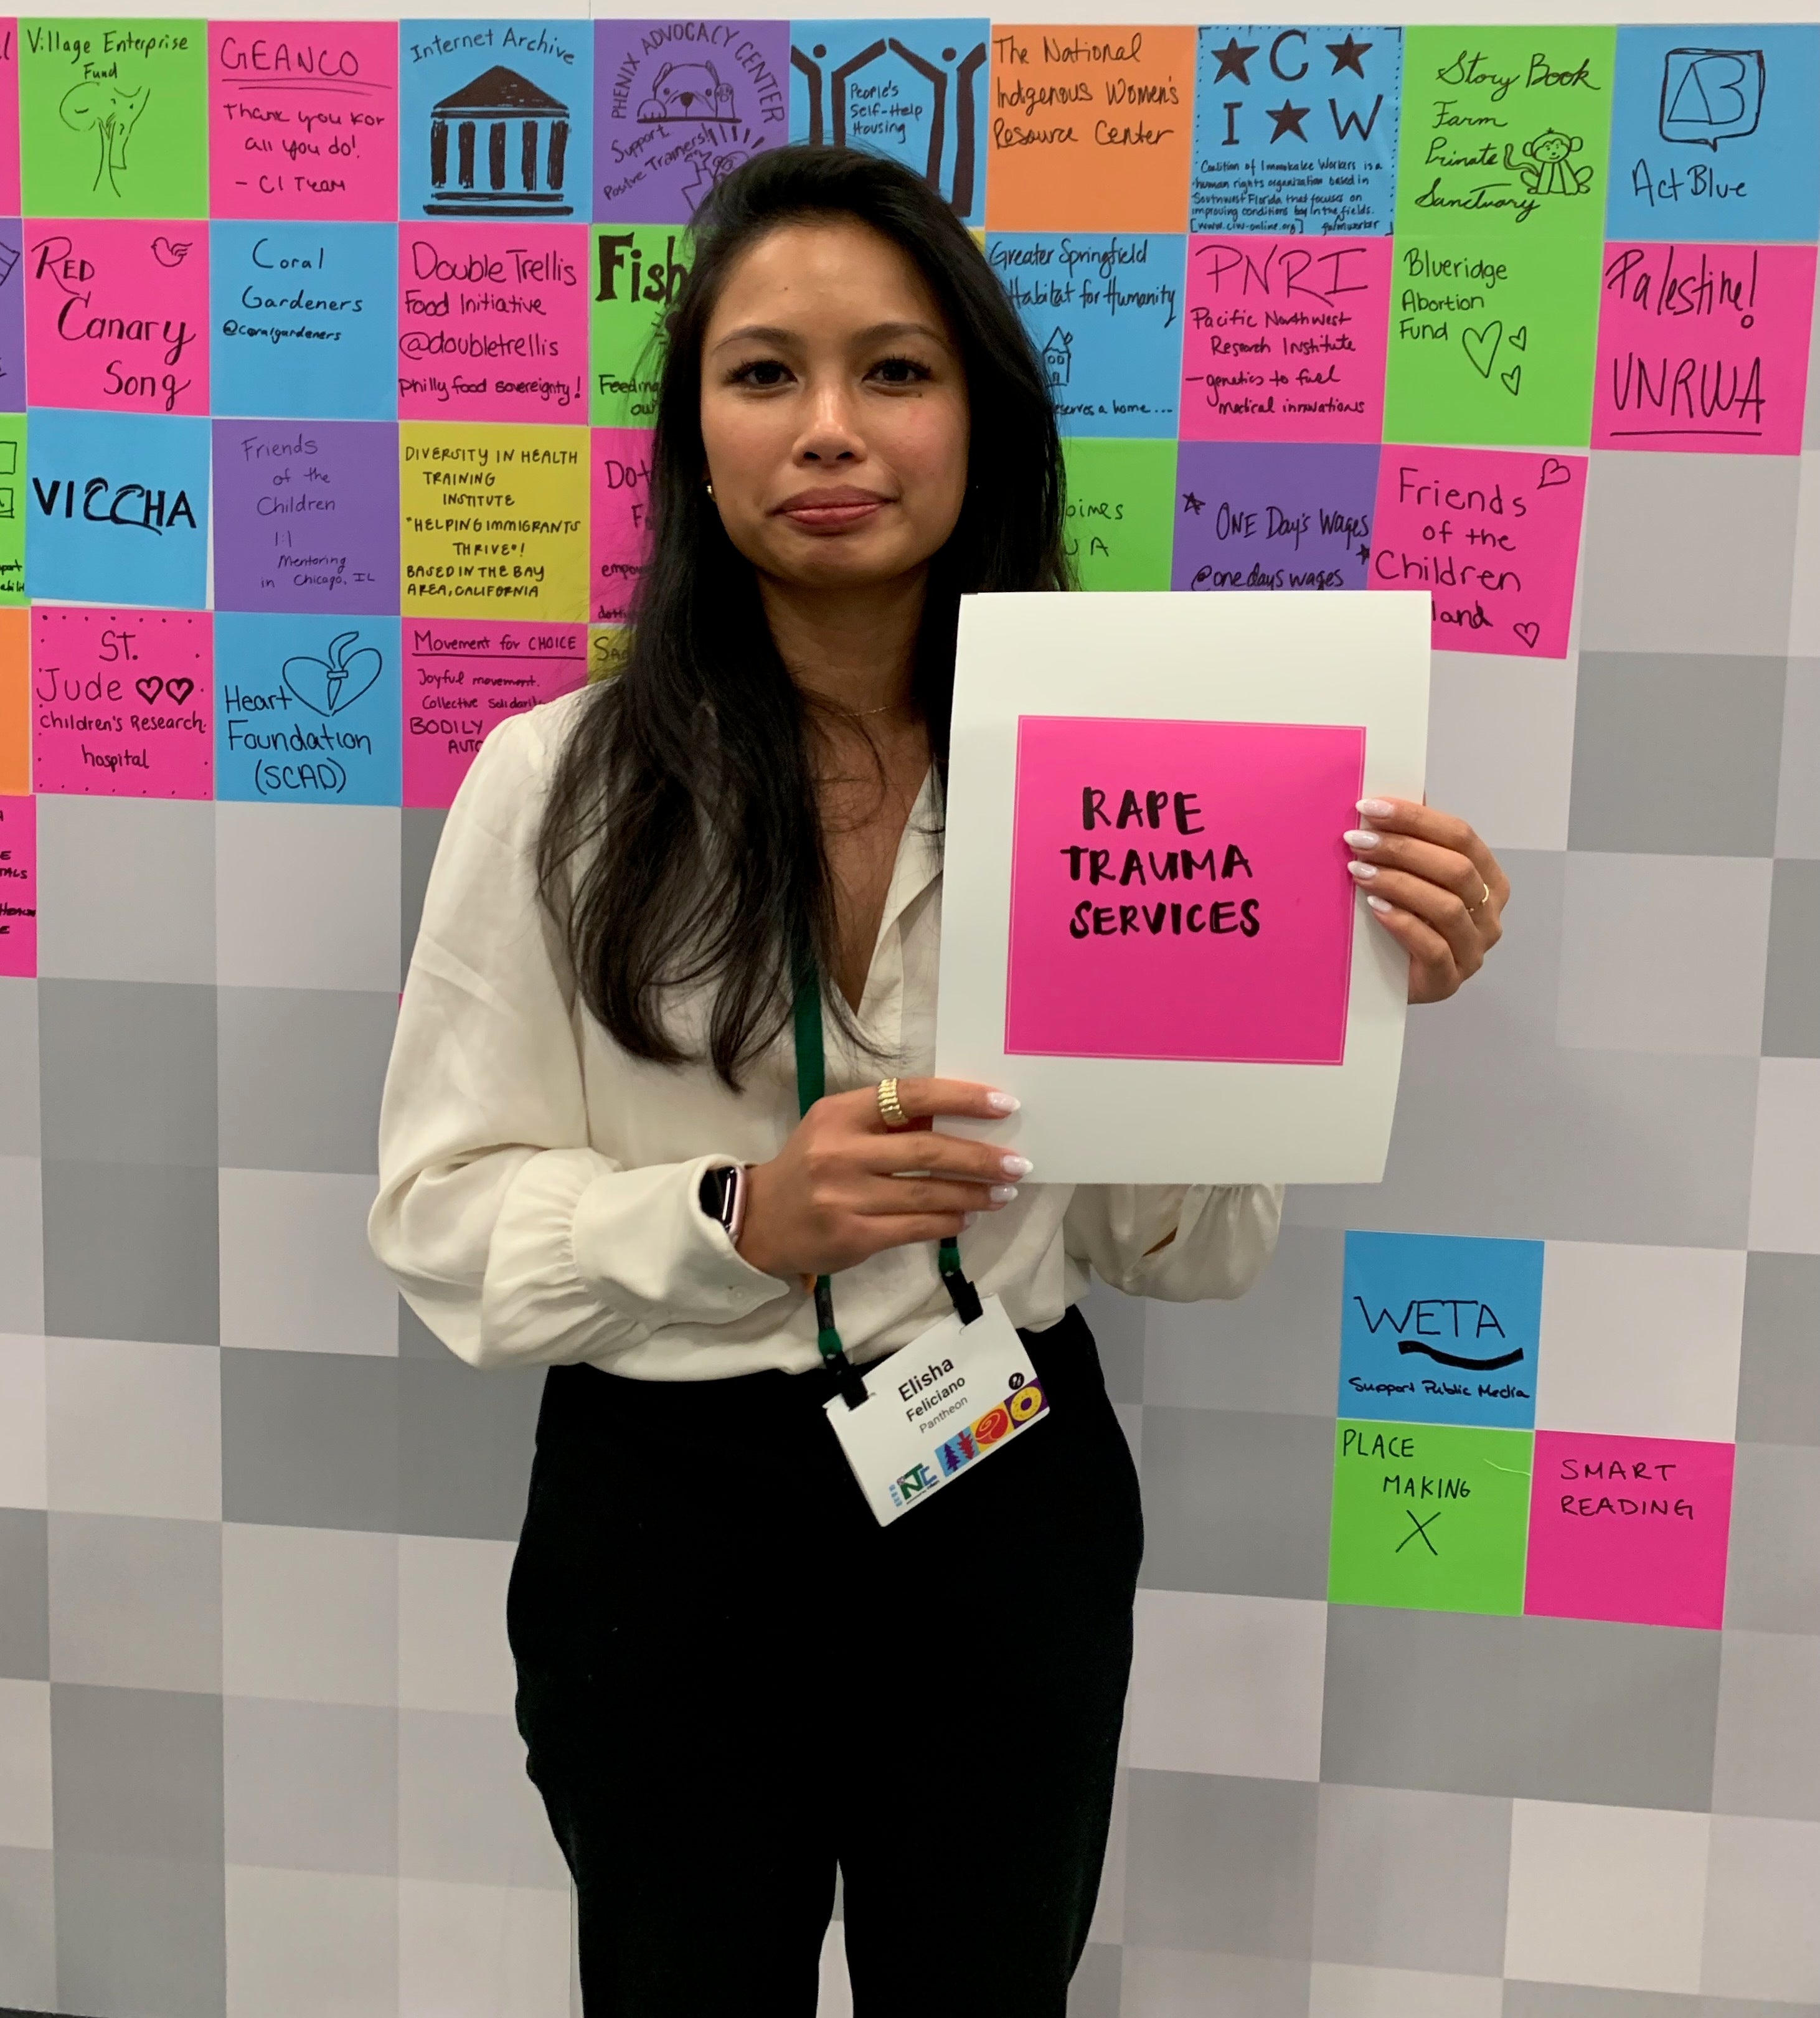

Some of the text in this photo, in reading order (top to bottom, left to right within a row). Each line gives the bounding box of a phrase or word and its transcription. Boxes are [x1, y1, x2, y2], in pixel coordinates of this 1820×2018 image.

[27, 29, 90, 64] Village
[103, 31, 189, 61] Enterprise
[411, 27, 574, 64] Internet Archive
[993, 32, 1142, 64] The National
[84, 62, 117, 80] Fund
[612, 22, 784, 124] PHENIX ADVOCACY CENTER
[1525, 53, 1601, 90] Book
[851, 80, 899, 100] People's
[997, 77, 1179, 117] Indigenous Women's
[298, 111, 342, 133] you
[851, 103, 923, 121] Self-Help
[1432, 100, 1508, 130] Farm
[611, 123, 671, 163] Support
[853, 121, 906, 144] Housing
[993, 119, 1174, 149] Resource Center
[245, 137, 272, 151] all
[283, 139, 319, 161] you
[1200, 159, 1239, 174] Coalition
[1245, 158, 1255, 176] of
[1318, 158, 1356, 171] Workers
[1233, 175, 1264, 194] rights
[1268, 177, 1323, 191] organization
[1329, 174, 1354, 186] based
[1359, 175, 1369, 186] in
[1192, 205, 1238, 223] improving
[1242, 205, 1288, 218] conditions
[1248, 194, 1282, 205] Florida
[1286, 194, 1309, 204] that
[1309, 193, 1343, 212] focuses
[1349, 194, 1362, 202] on
[1414, 177, 1541, 224] Sanctuary
[252, 238, 324, 270] Coral
[1195, 244, 1367, 308] PNRI
[242, 285, 363, 313] Gardeners
[461, 293, 547, 315] Initiative
[1080, 280, 1100, 308] for
[1401, 289, 1484, 311] Abortion
[57, 291, 196, 365] Canary
[1191, 307, 1258, 330] Pacific
[1399, 318, 1448, 342] Fund
[399, 332, 559, 360] @doubletrellis
[1210, 336, 1357, 356] Research Institute
[103, 360, 191, 411] Song
[451, 375, 488, 394] food
[1269, 371, 1289, 386] to
[1614, 351, 1766, 423] UNRWA
[241, 433, 318, 462] Friends
[405, 447, 578, 466] DIVERSITY IN HEALTH
[273, 468, 331, 486] of the
[422, 471, 496, 486] TRAINING
[1398, 466, 1527, 516] Friends
[32, 476, 197, 535] VICCHA
[256, 496, 336, 516] Children
[442, 493, 515, 507] INSTITUTE
[1422, 522, 1517, 552] of the
[260, 577, 275, 588] in
[353, 573, 375, 583] IL
[407, 563, 544, 582] BASED IN THE BAY
[1375, 550, 1522, 593] Children
[455, 585, 539, 598] CALIFORNIA
[413, 630, 491, 651] Movement
[499, 628, 521, 650] for
[528, 635, 576, 651] CHOICE
[36, 667, 123, 702] Jude
[418, 668, 464, 687] Joyful
[225, 685, 293, 715] Heart
[422, 694, 478, 710] Collective
[227, 719, 372, 755] Foundation
[409, 717, 483, 736] BODILY
[254, 758, 347, 796] (SCAD)
[1082, 786, 1205, 836] RAPE
[1060, 844, 1253, 886] TRAUMA
[1069, 898, 1261, 939] SERVICES
[1353, 1296, 1506, 1339] WETA
[898, 1357, 955, 1403] Elisha
[1349, 1377, 1531, 1400] Support Public Media
[906, 1376, 966, 1423] Feliciano
[919, 1396, 968, 1435] Pantheon
[1342, 1428, 1415, 1459] PLACE
[1560, 1458, 1677, 1482] SMART
[1383, 1474, 1472, 1499] MAKING
[1561, 1495, 1694, 1521] READING
